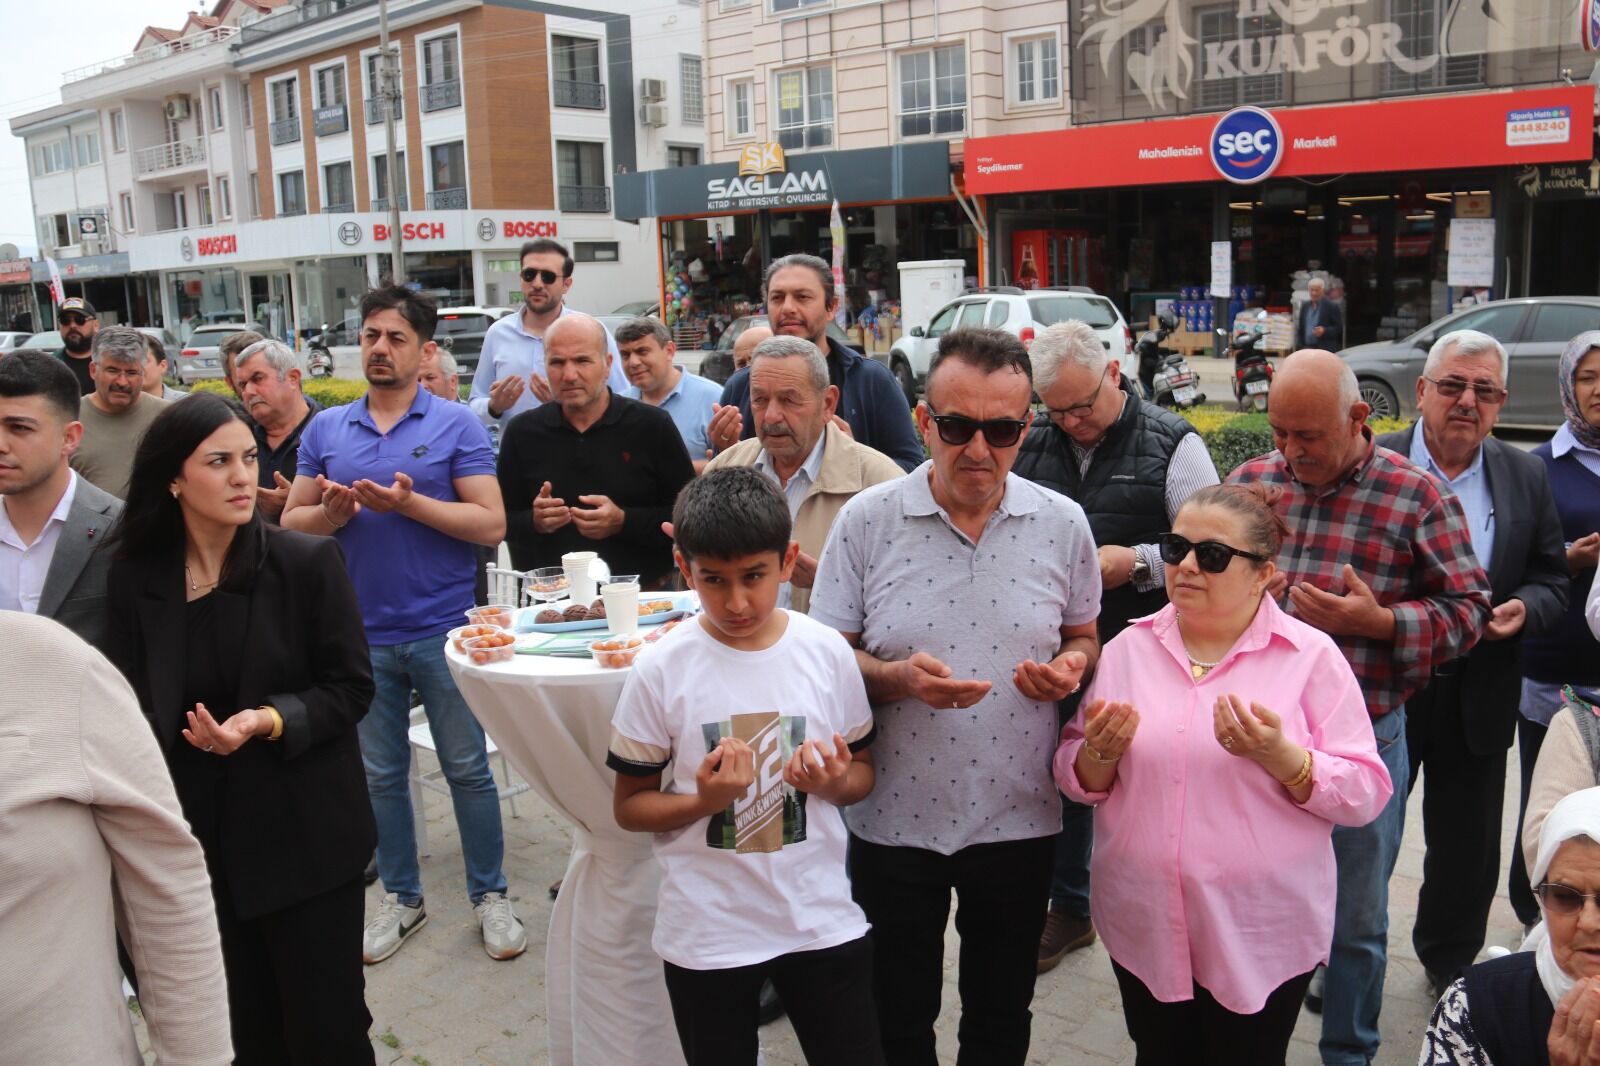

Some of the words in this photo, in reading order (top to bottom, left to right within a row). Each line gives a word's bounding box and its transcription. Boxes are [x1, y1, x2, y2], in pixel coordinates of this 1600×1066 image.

[1204, 15, 1439, 80] KUAFÖR
[1218, 128, 1272, 156] seç
[1293, 135, 1337, 149] Marketi
[745, 143, 777, 168] SK
[1138, 145, 1203, 159] Mahallenizin
[977, 163, 1024, 175] Seydikemer
[1544, 178, 1588, 189] KUAFÖR
[786, 192, 828, 203] OYUNCAK
[372, 222, 445, 241] BSCH
[502, 221, 557, 238] BOSCH
[196, 234, 237, 256] BOSCH
